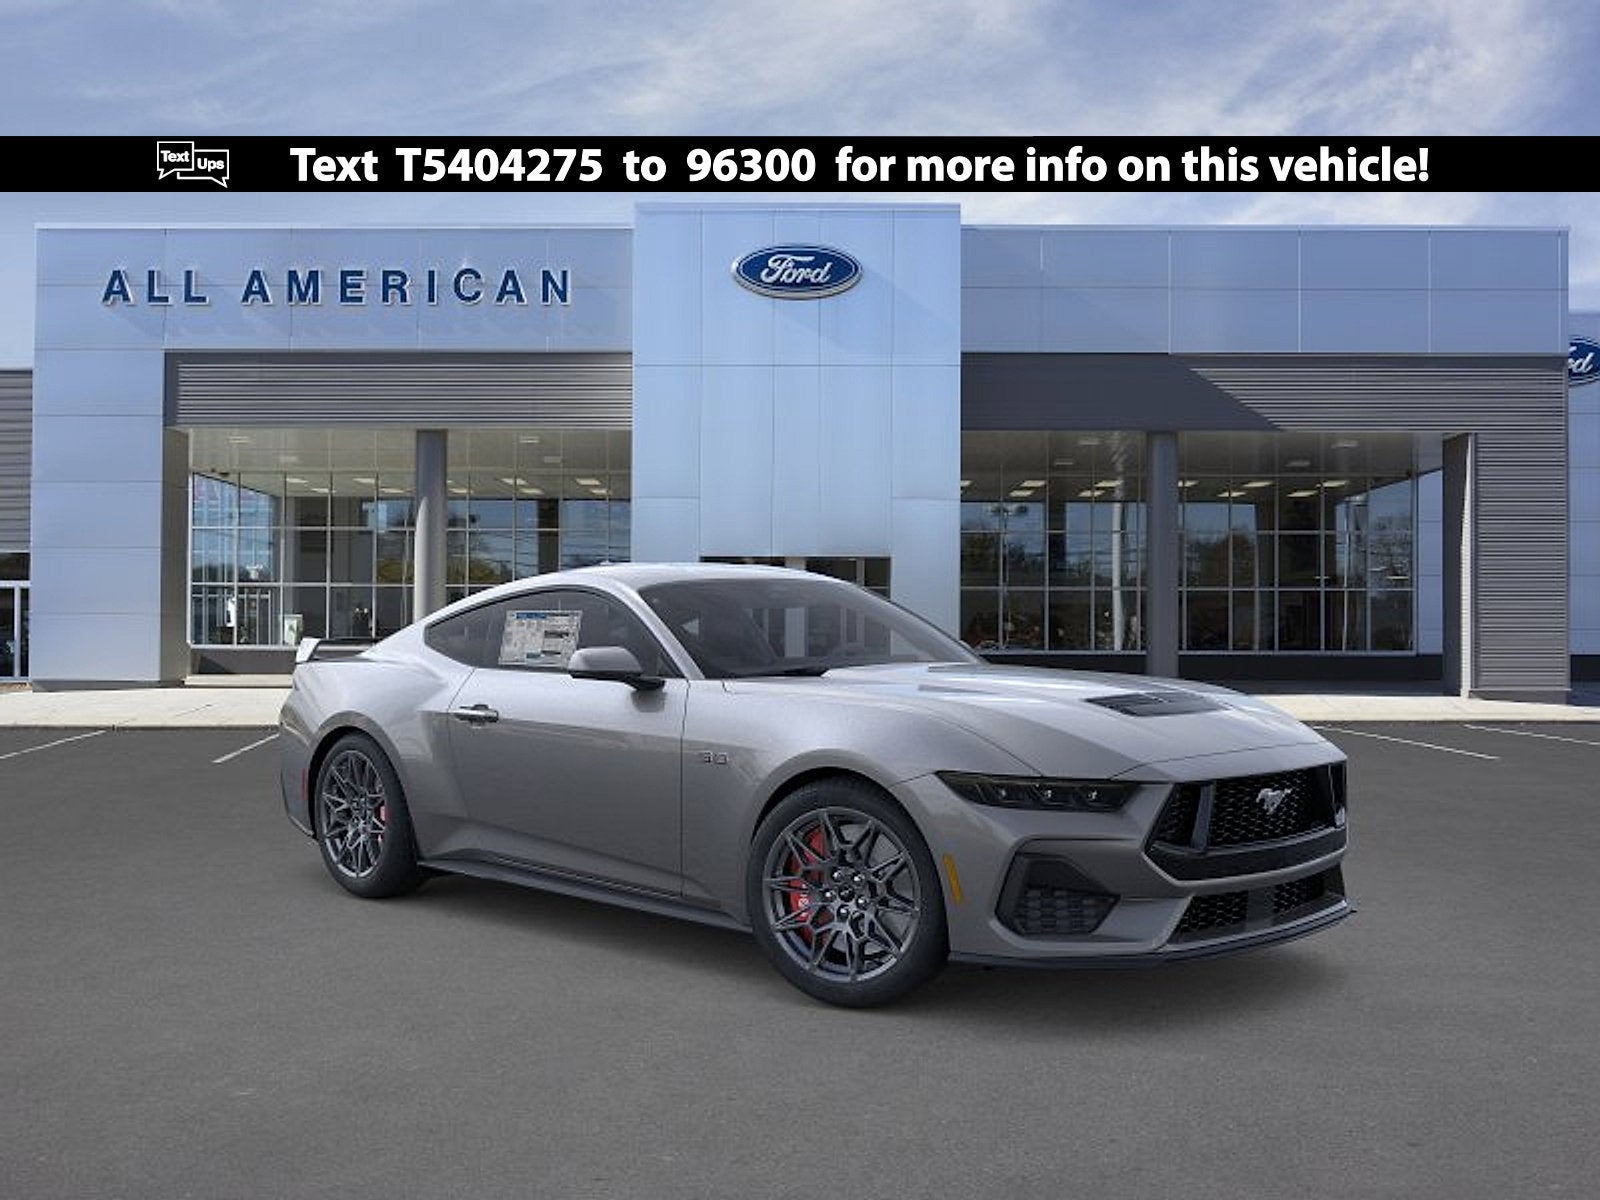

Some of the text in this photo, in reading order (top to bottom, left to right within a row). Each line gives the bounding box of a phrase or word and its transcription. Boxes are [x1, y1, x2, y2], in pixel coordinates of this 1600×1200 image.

[761, 254, 833, 283] Ford
[102, 268, 570, 305] ALL AMERICAN
